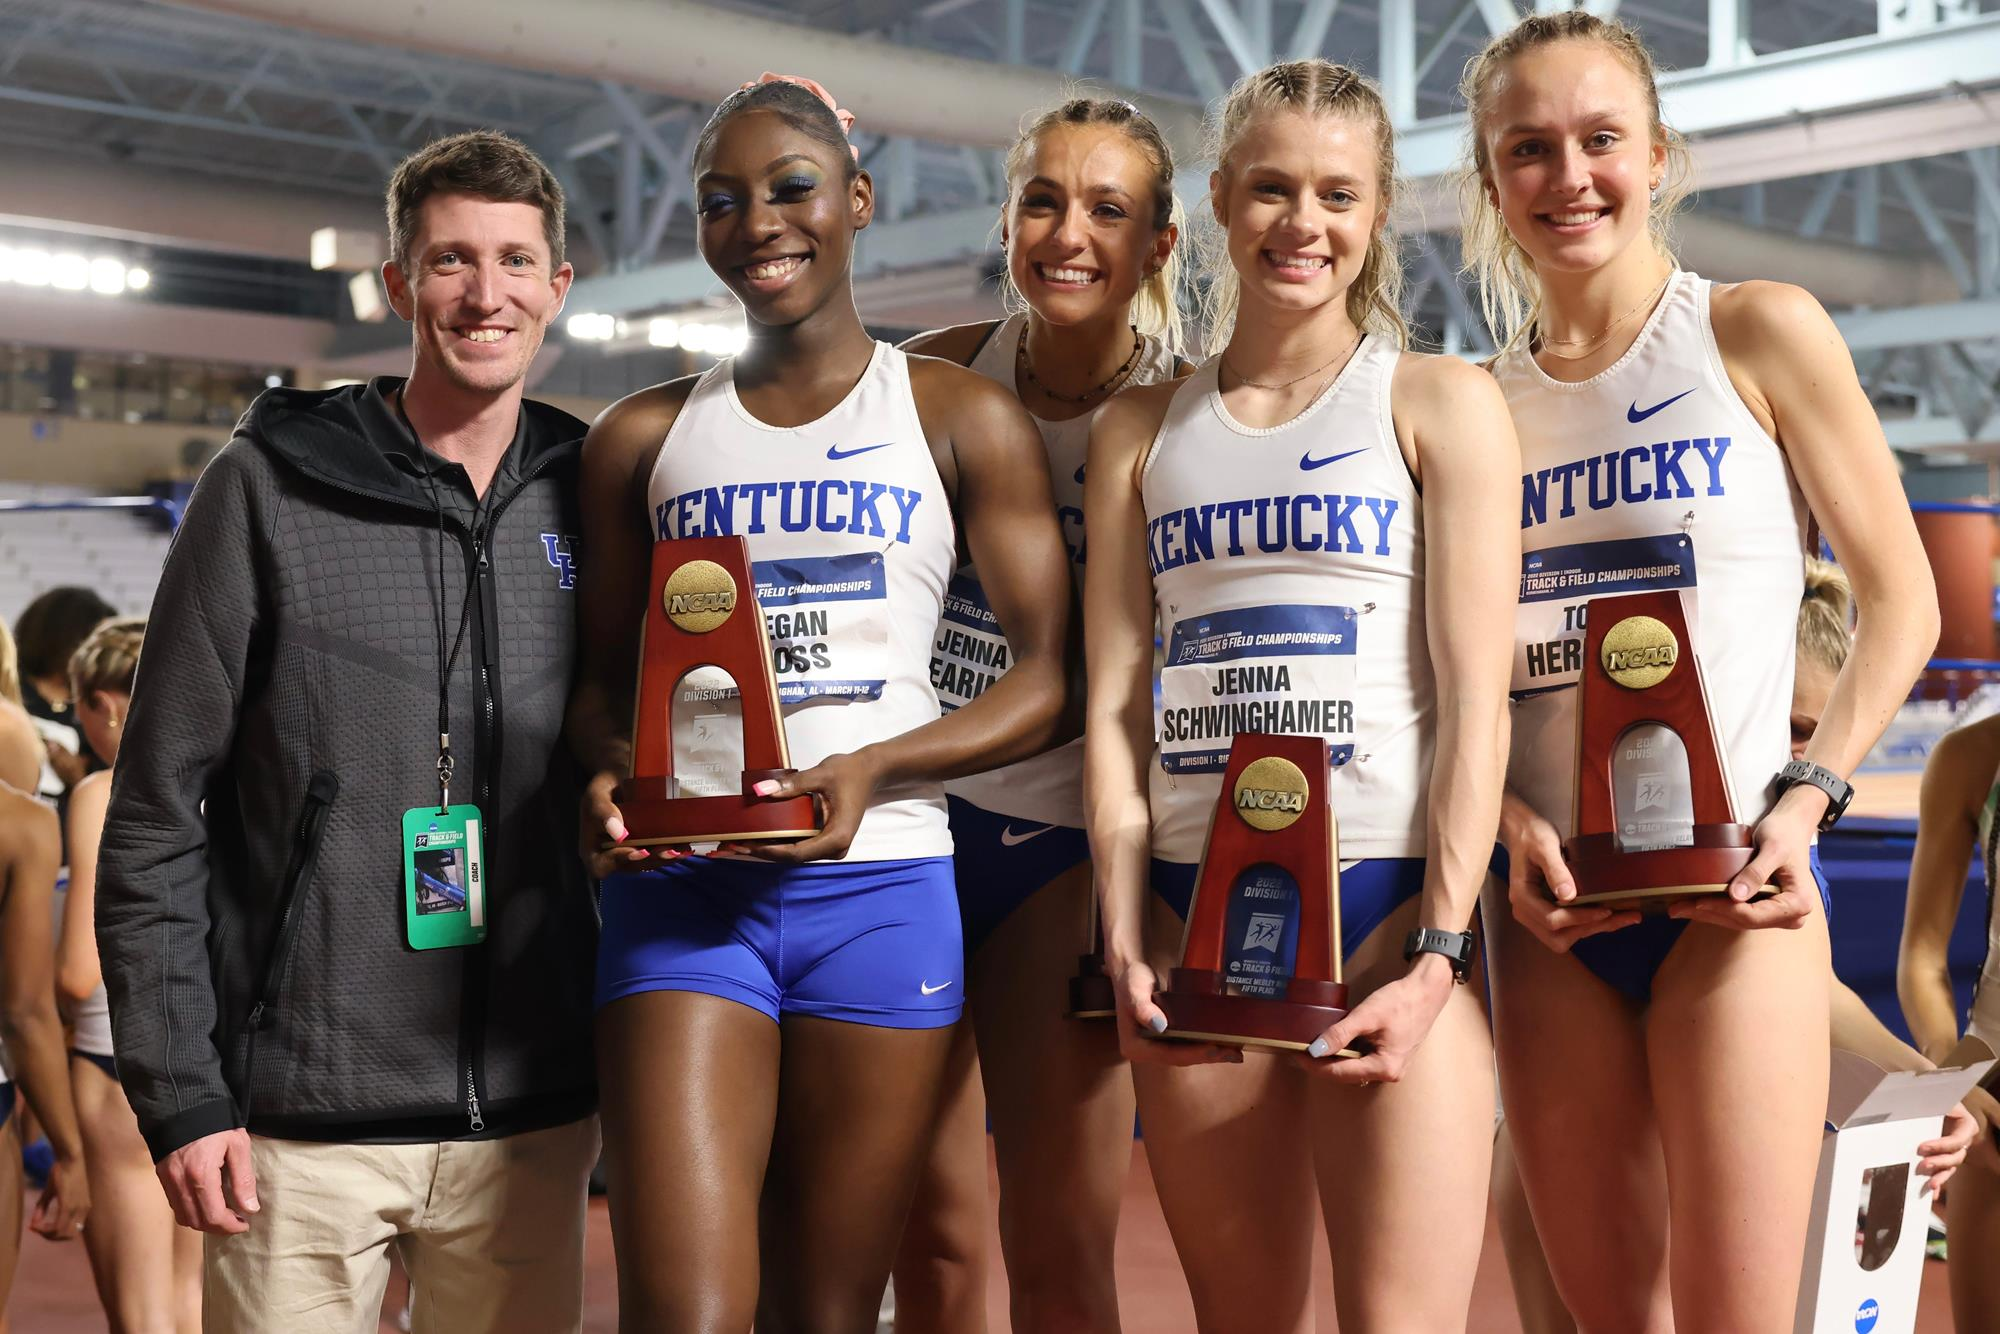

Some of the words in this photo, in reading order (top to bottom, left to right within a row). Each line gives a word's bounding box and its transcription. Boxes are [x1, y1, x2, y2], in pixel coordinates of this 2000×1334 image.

[1520, 437, 1731, 529] NTUCKY
[655, 480, 921, 544] KENTUCKY
[1147, 494, 1398, 577] KENTUCKY
[758, 586, 785, 598] FIELD
[788, 580, 871, 596] CHAMPIONSHIPS
[1526, 576, 1558, 590] TRACK
[1560, 575, 1566, 587] &
[1568, 572, 1595, 586] FIELD
[1597, 564, 1681, 583] CHAMPIONSHIPS
[671, 592, 732, 614] NCAA
[960, 604, 983, 619] FIELD
[766, 610, 828, 640] EGAN
[1563, 604, 1587, 631] TO
[936, 629, 1007, 670] JENNA
[1199, 639, 1222, 654] TRACK
[1221, 639, 1228, 650] &
[1229, 635, 1254, 648] FIELD
[1255, 632, 1343, 645] CHAMPIONSHIPS
[773, 642, 831, 674] OSS
[1526, 638, 1581, 678] HER
[1608, 646, 1675, 672] NCAA
[825, 686, 852, 695] MARCH
[854, 685, 870, 695] 11-12
[1212, 665, 1291, 696] JENNA
[684, 689, 725, 702] DIVISION
[1164, 700, 1354, 742] SCHWINGHAMER
[1179, 755, 1208, 766] DIVISION
[1239, 789, 1303, 811] NCAA
[471, 862, 479, 882] COACH
[1243, 886, 1287, 900] DIVISION
[1242, 963, 1264, 973] TRACK
